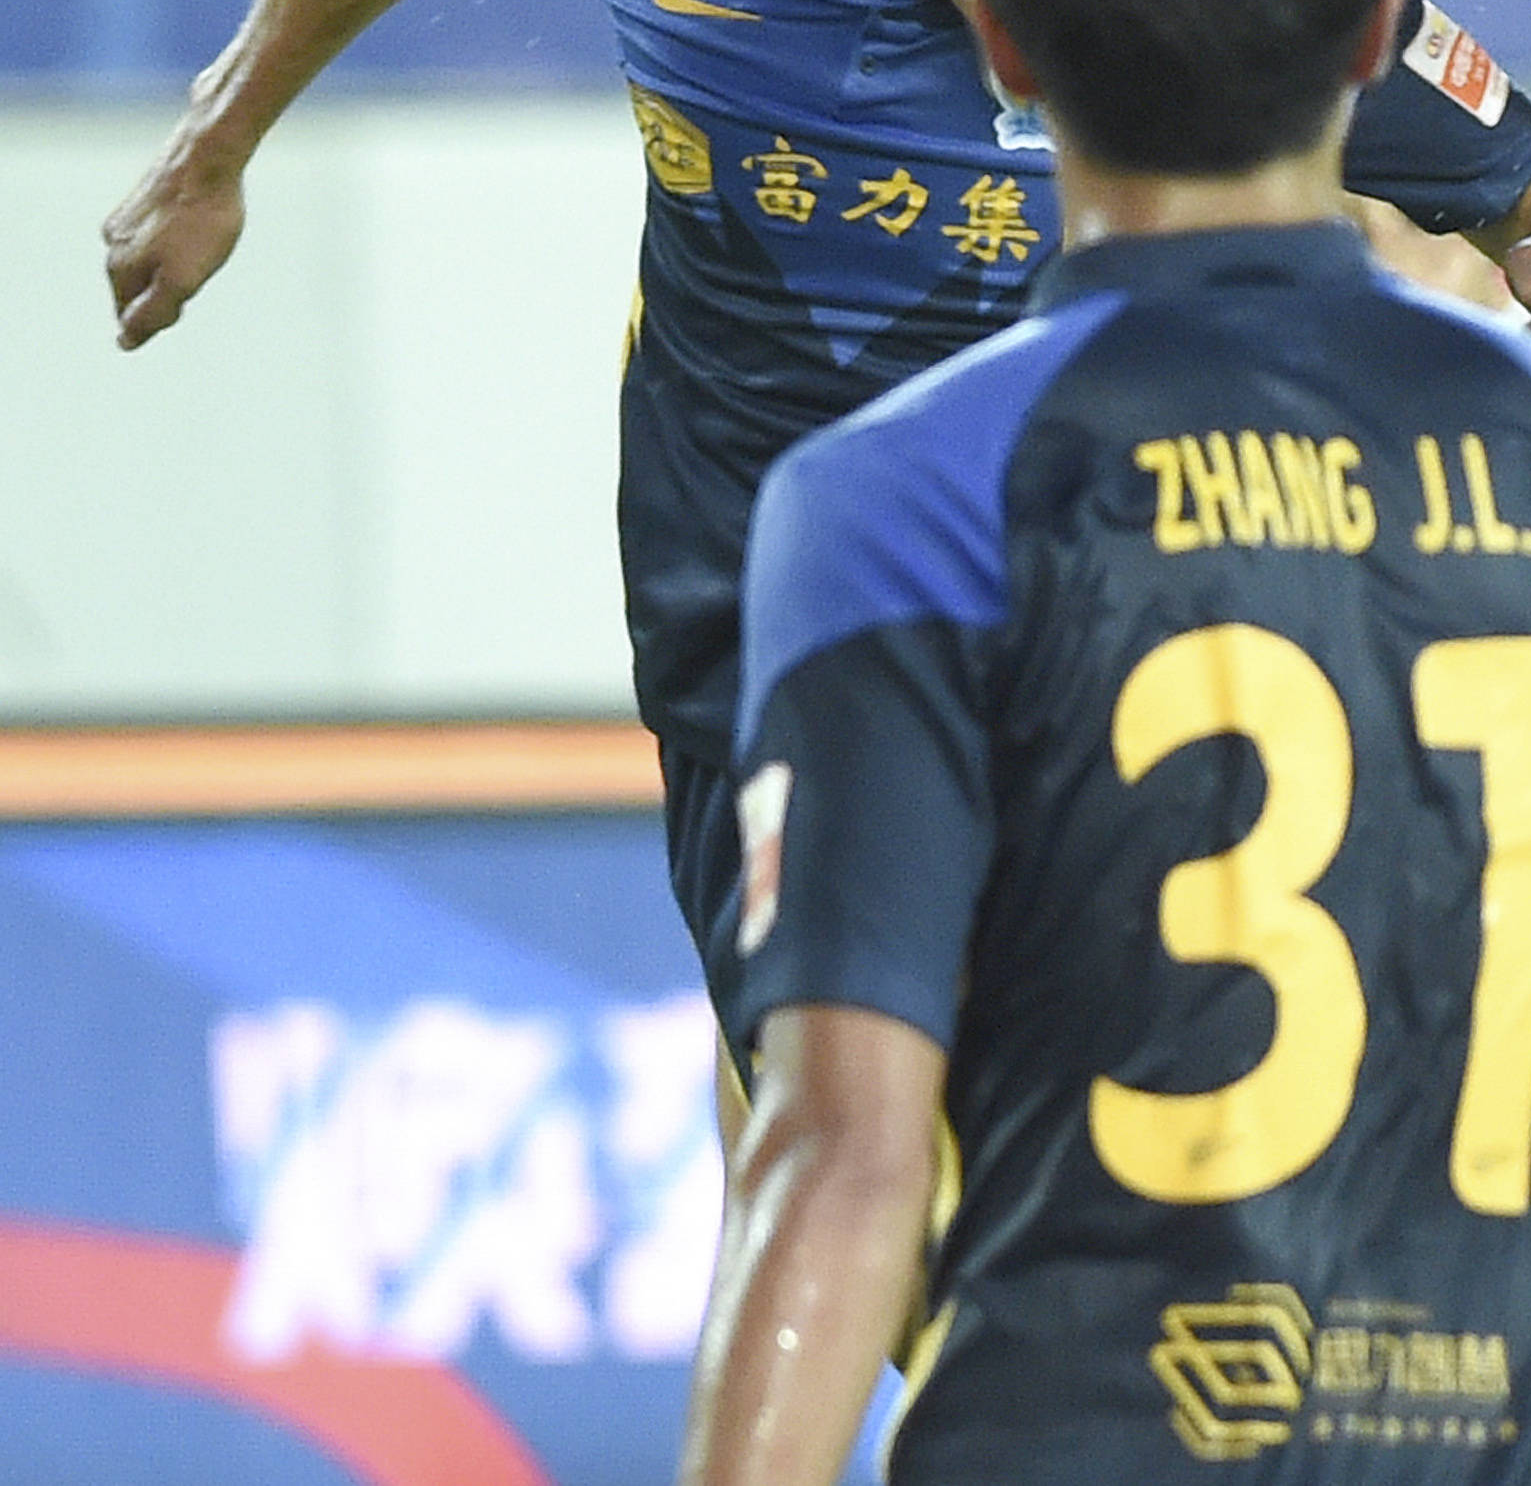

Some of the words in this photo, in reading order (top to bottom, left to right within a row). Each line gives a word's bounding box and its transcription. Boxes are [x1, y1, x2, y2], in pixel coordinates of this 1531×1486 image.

[740, 134, 1042, 264] 富力集
[1133, 428, 1377, 556] ZHANG
